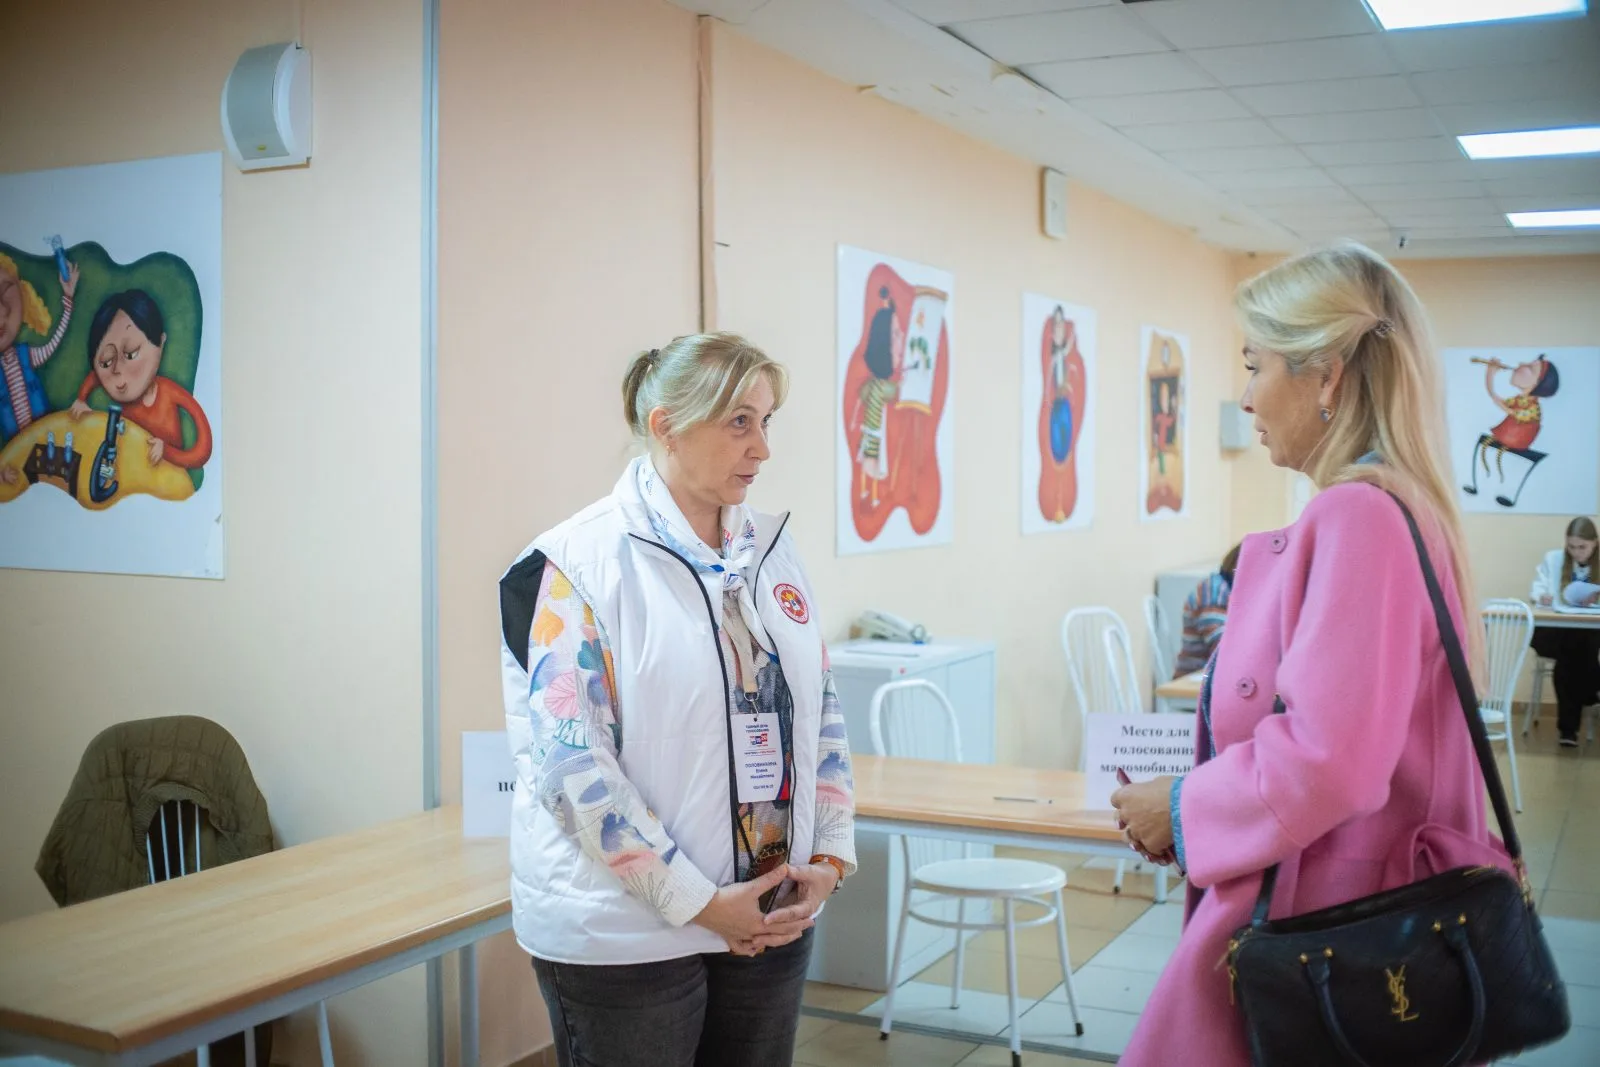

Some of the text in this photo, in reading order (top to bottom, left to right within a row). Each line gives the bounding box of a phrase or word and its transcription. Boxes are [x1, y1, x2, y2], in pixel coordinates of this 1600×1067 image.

[1121, 725, 1190, 737] Место для
[1100, 761, 1194, 773] маомобильн
[1385, 964, 1420, 1021] YSL
